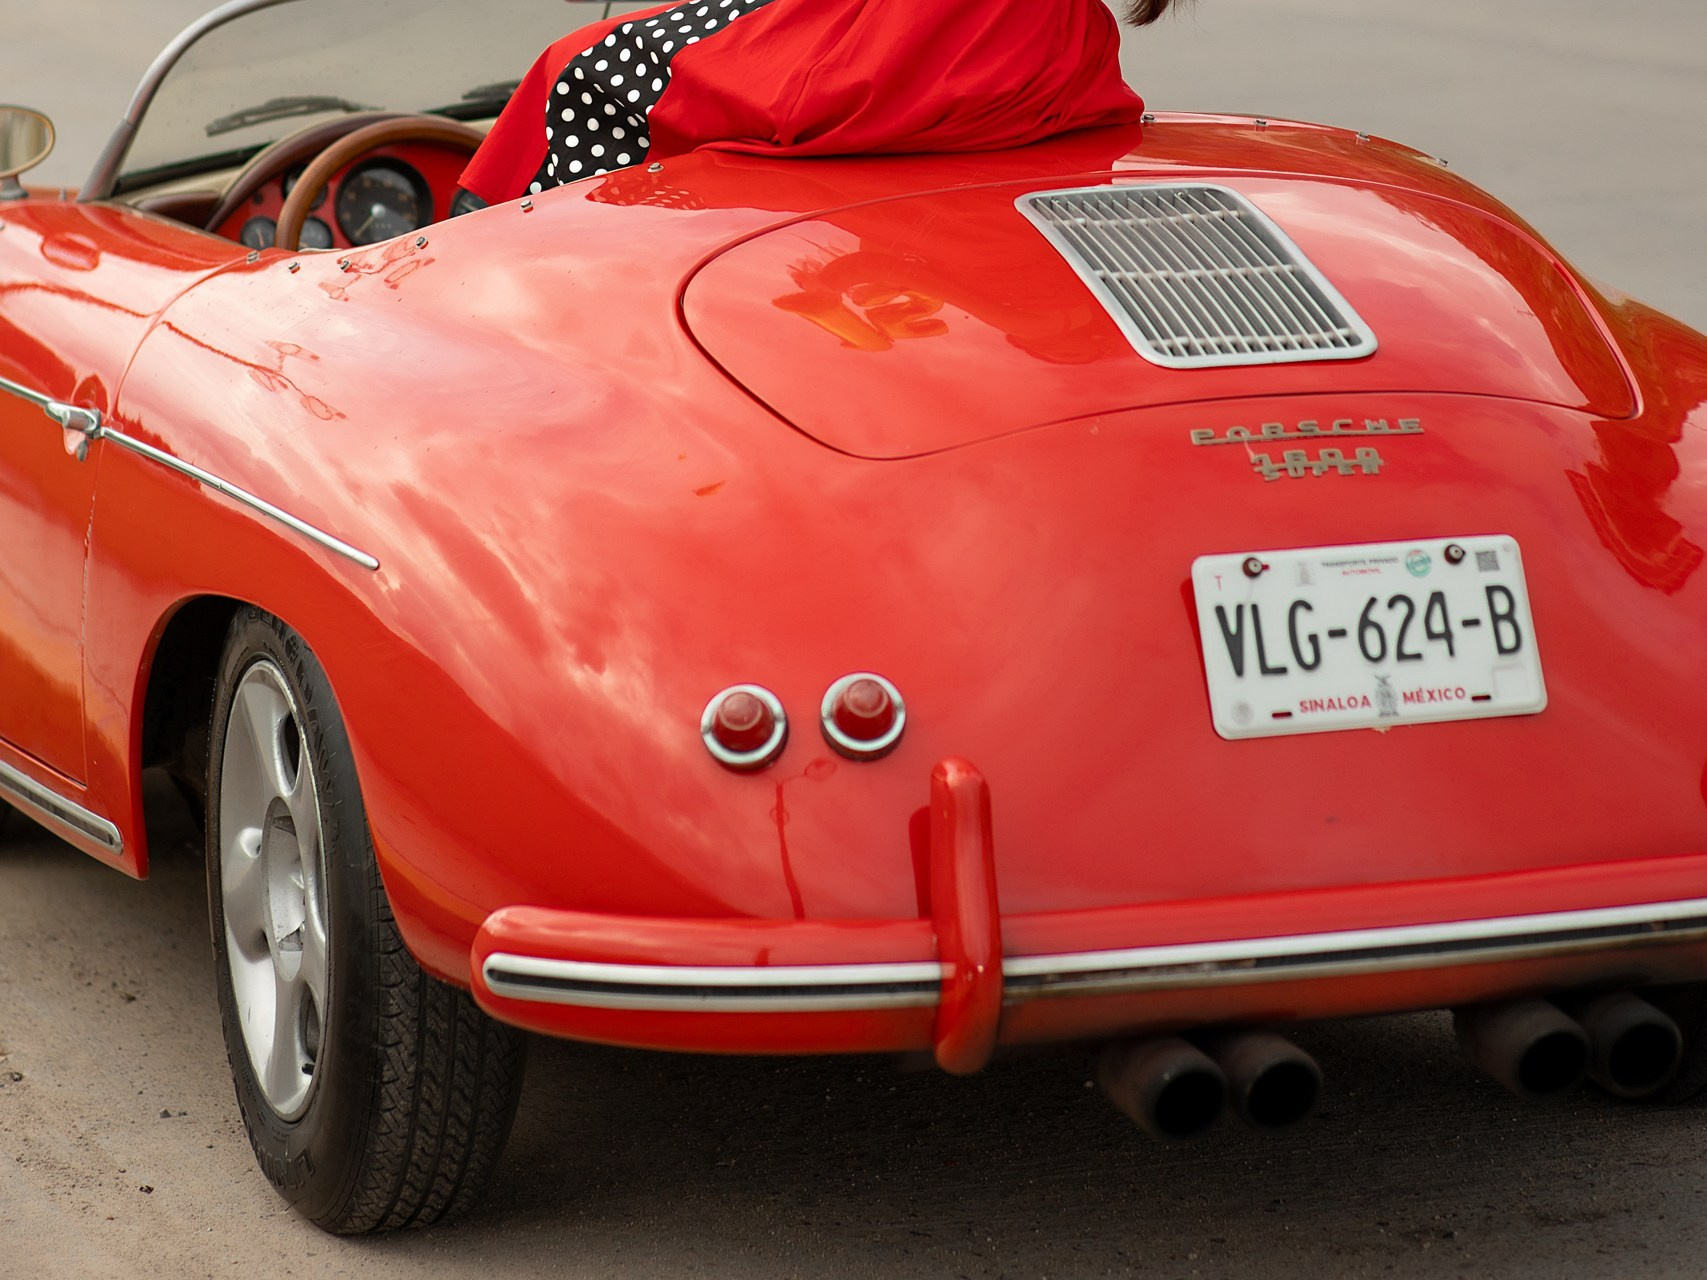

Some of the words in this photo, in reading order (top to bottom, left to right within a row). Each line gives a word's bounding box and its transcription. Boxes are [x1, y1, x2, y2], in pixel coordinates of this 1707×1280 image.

[1190, 418, 1424, 445] PORSCHE
[1214, 584, 1523, 678] VLG-624-B
[1299, 694, 1373, 714] SINALOA
[1402, 686, 1467, 705] MÉXICO
